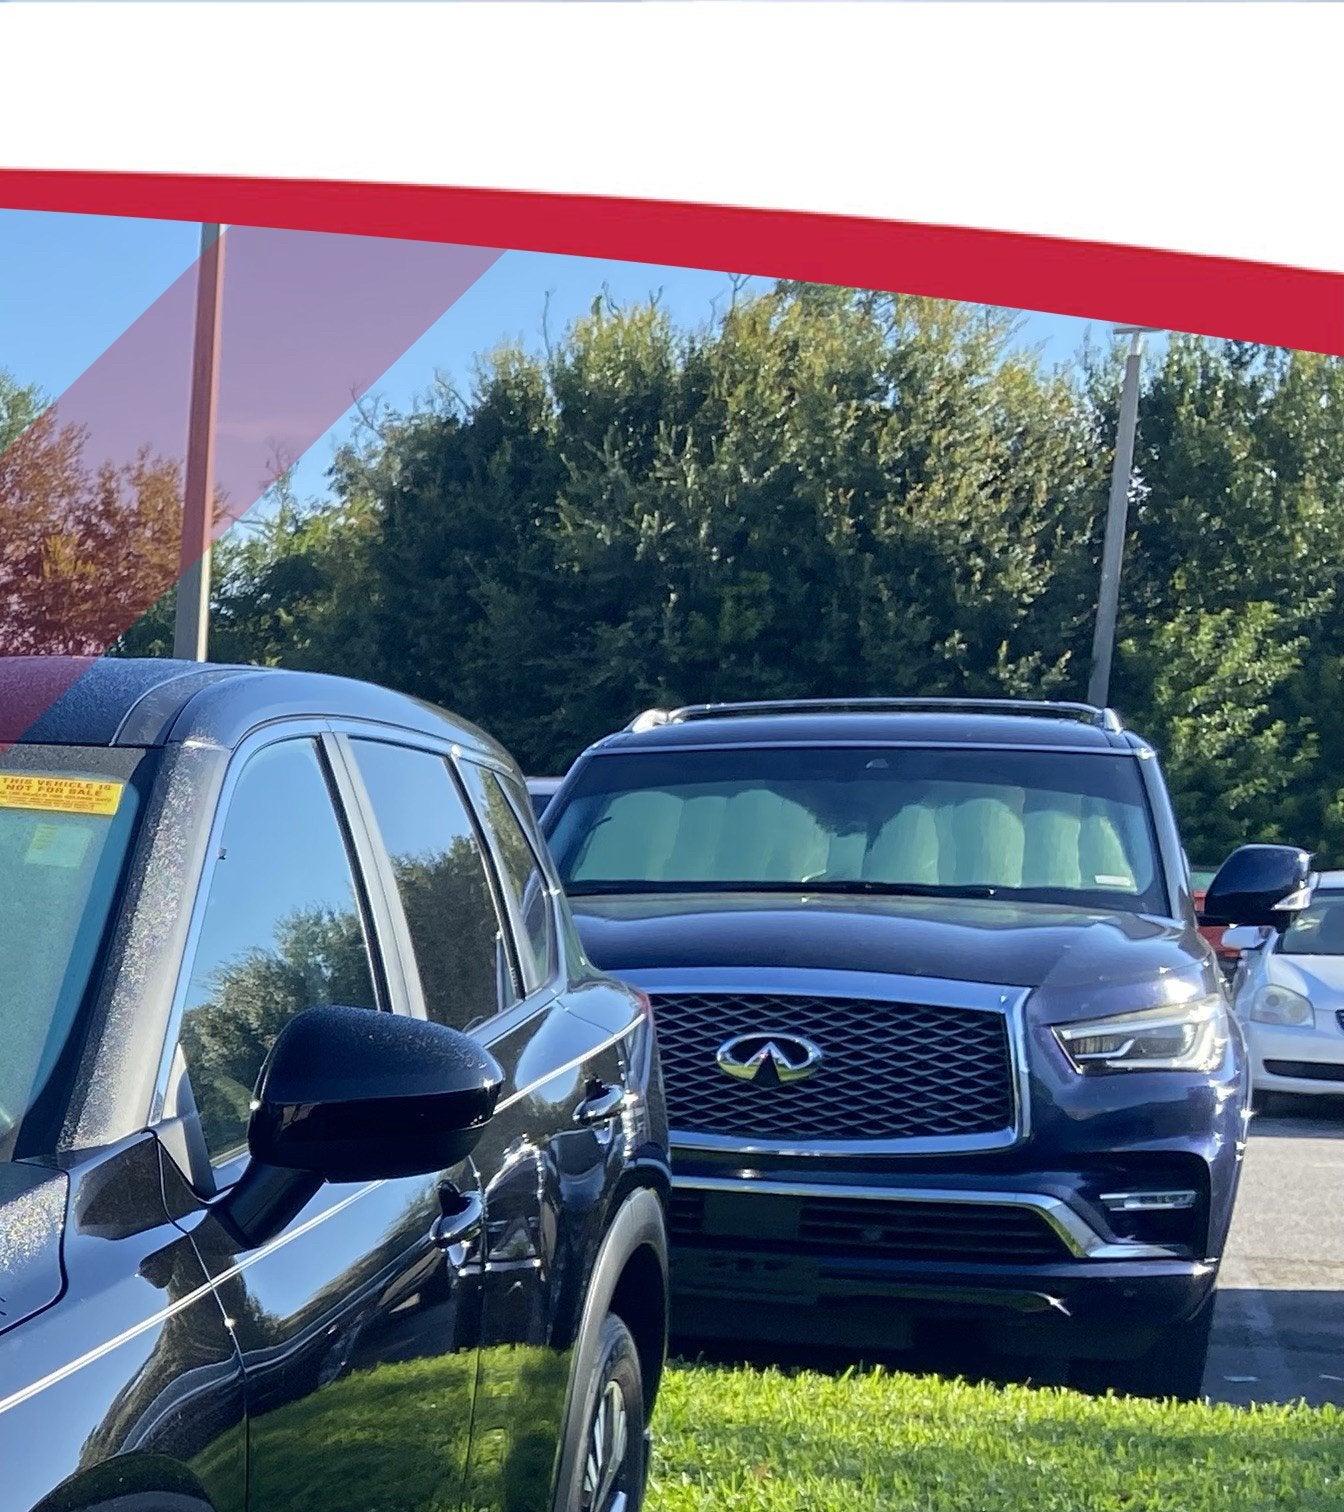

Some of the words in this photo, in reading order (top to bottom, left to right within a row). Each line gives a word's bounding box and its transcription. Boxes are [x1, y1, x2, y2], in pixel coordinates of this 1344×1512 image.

[6, 784, 33, 792] NOT
[37, 786, 64, 794] FOR
[69, 788, 103, 797] SALE
